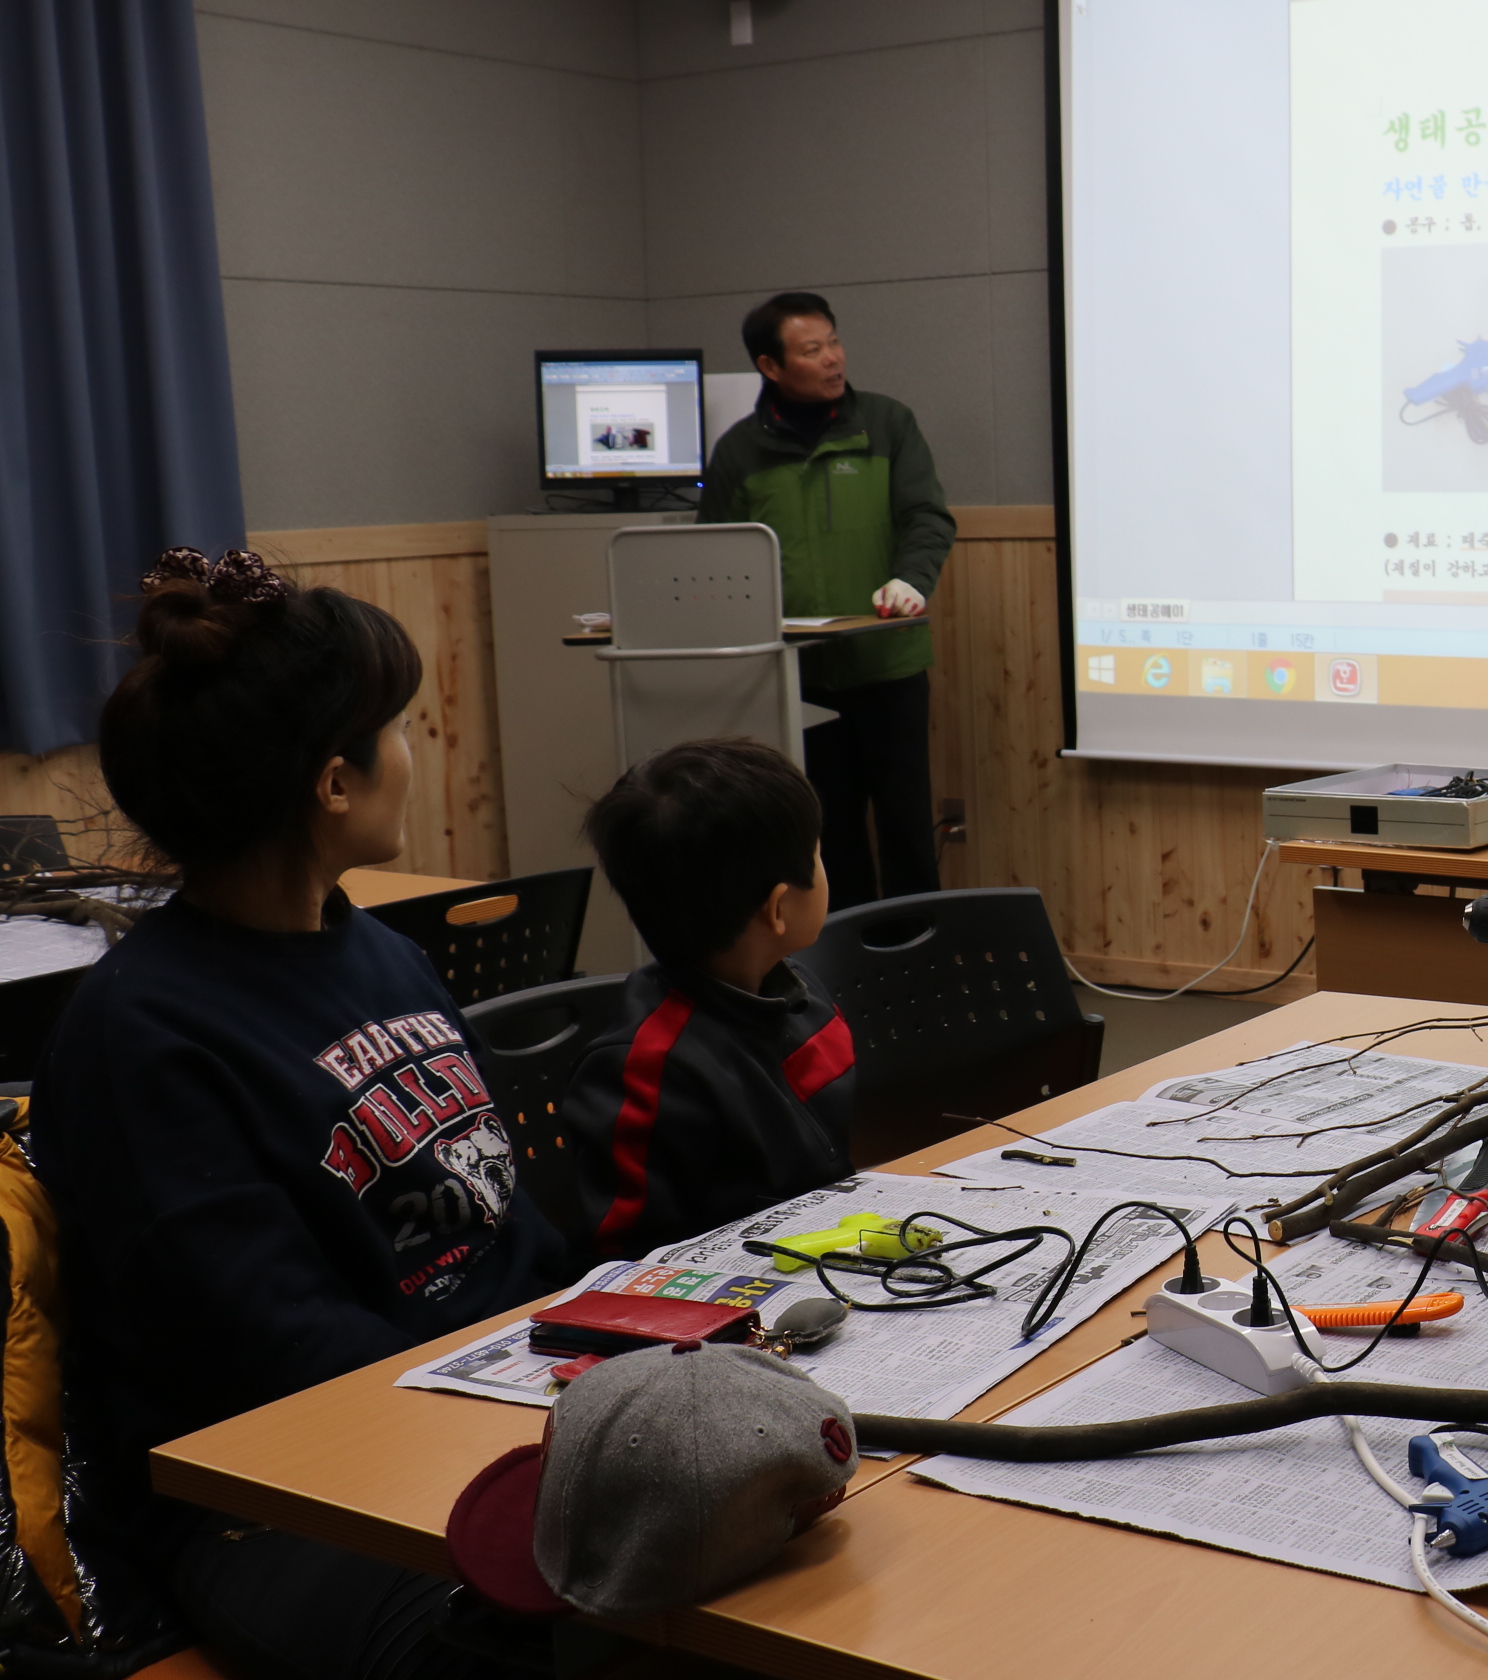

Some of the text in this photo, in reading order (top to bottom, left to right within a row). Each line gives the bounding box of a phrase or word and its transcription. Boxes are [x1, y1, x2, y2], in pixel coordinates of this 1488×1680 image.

[1382, 173, 1448, 202] 자연물
[1405, 216, 1437, 235] 공구
[1406, 530, 1439, 549] 재료
[320, 1051, 495, 1201] BULLD
[398, 1245, 471, 1296] OUTWIT
